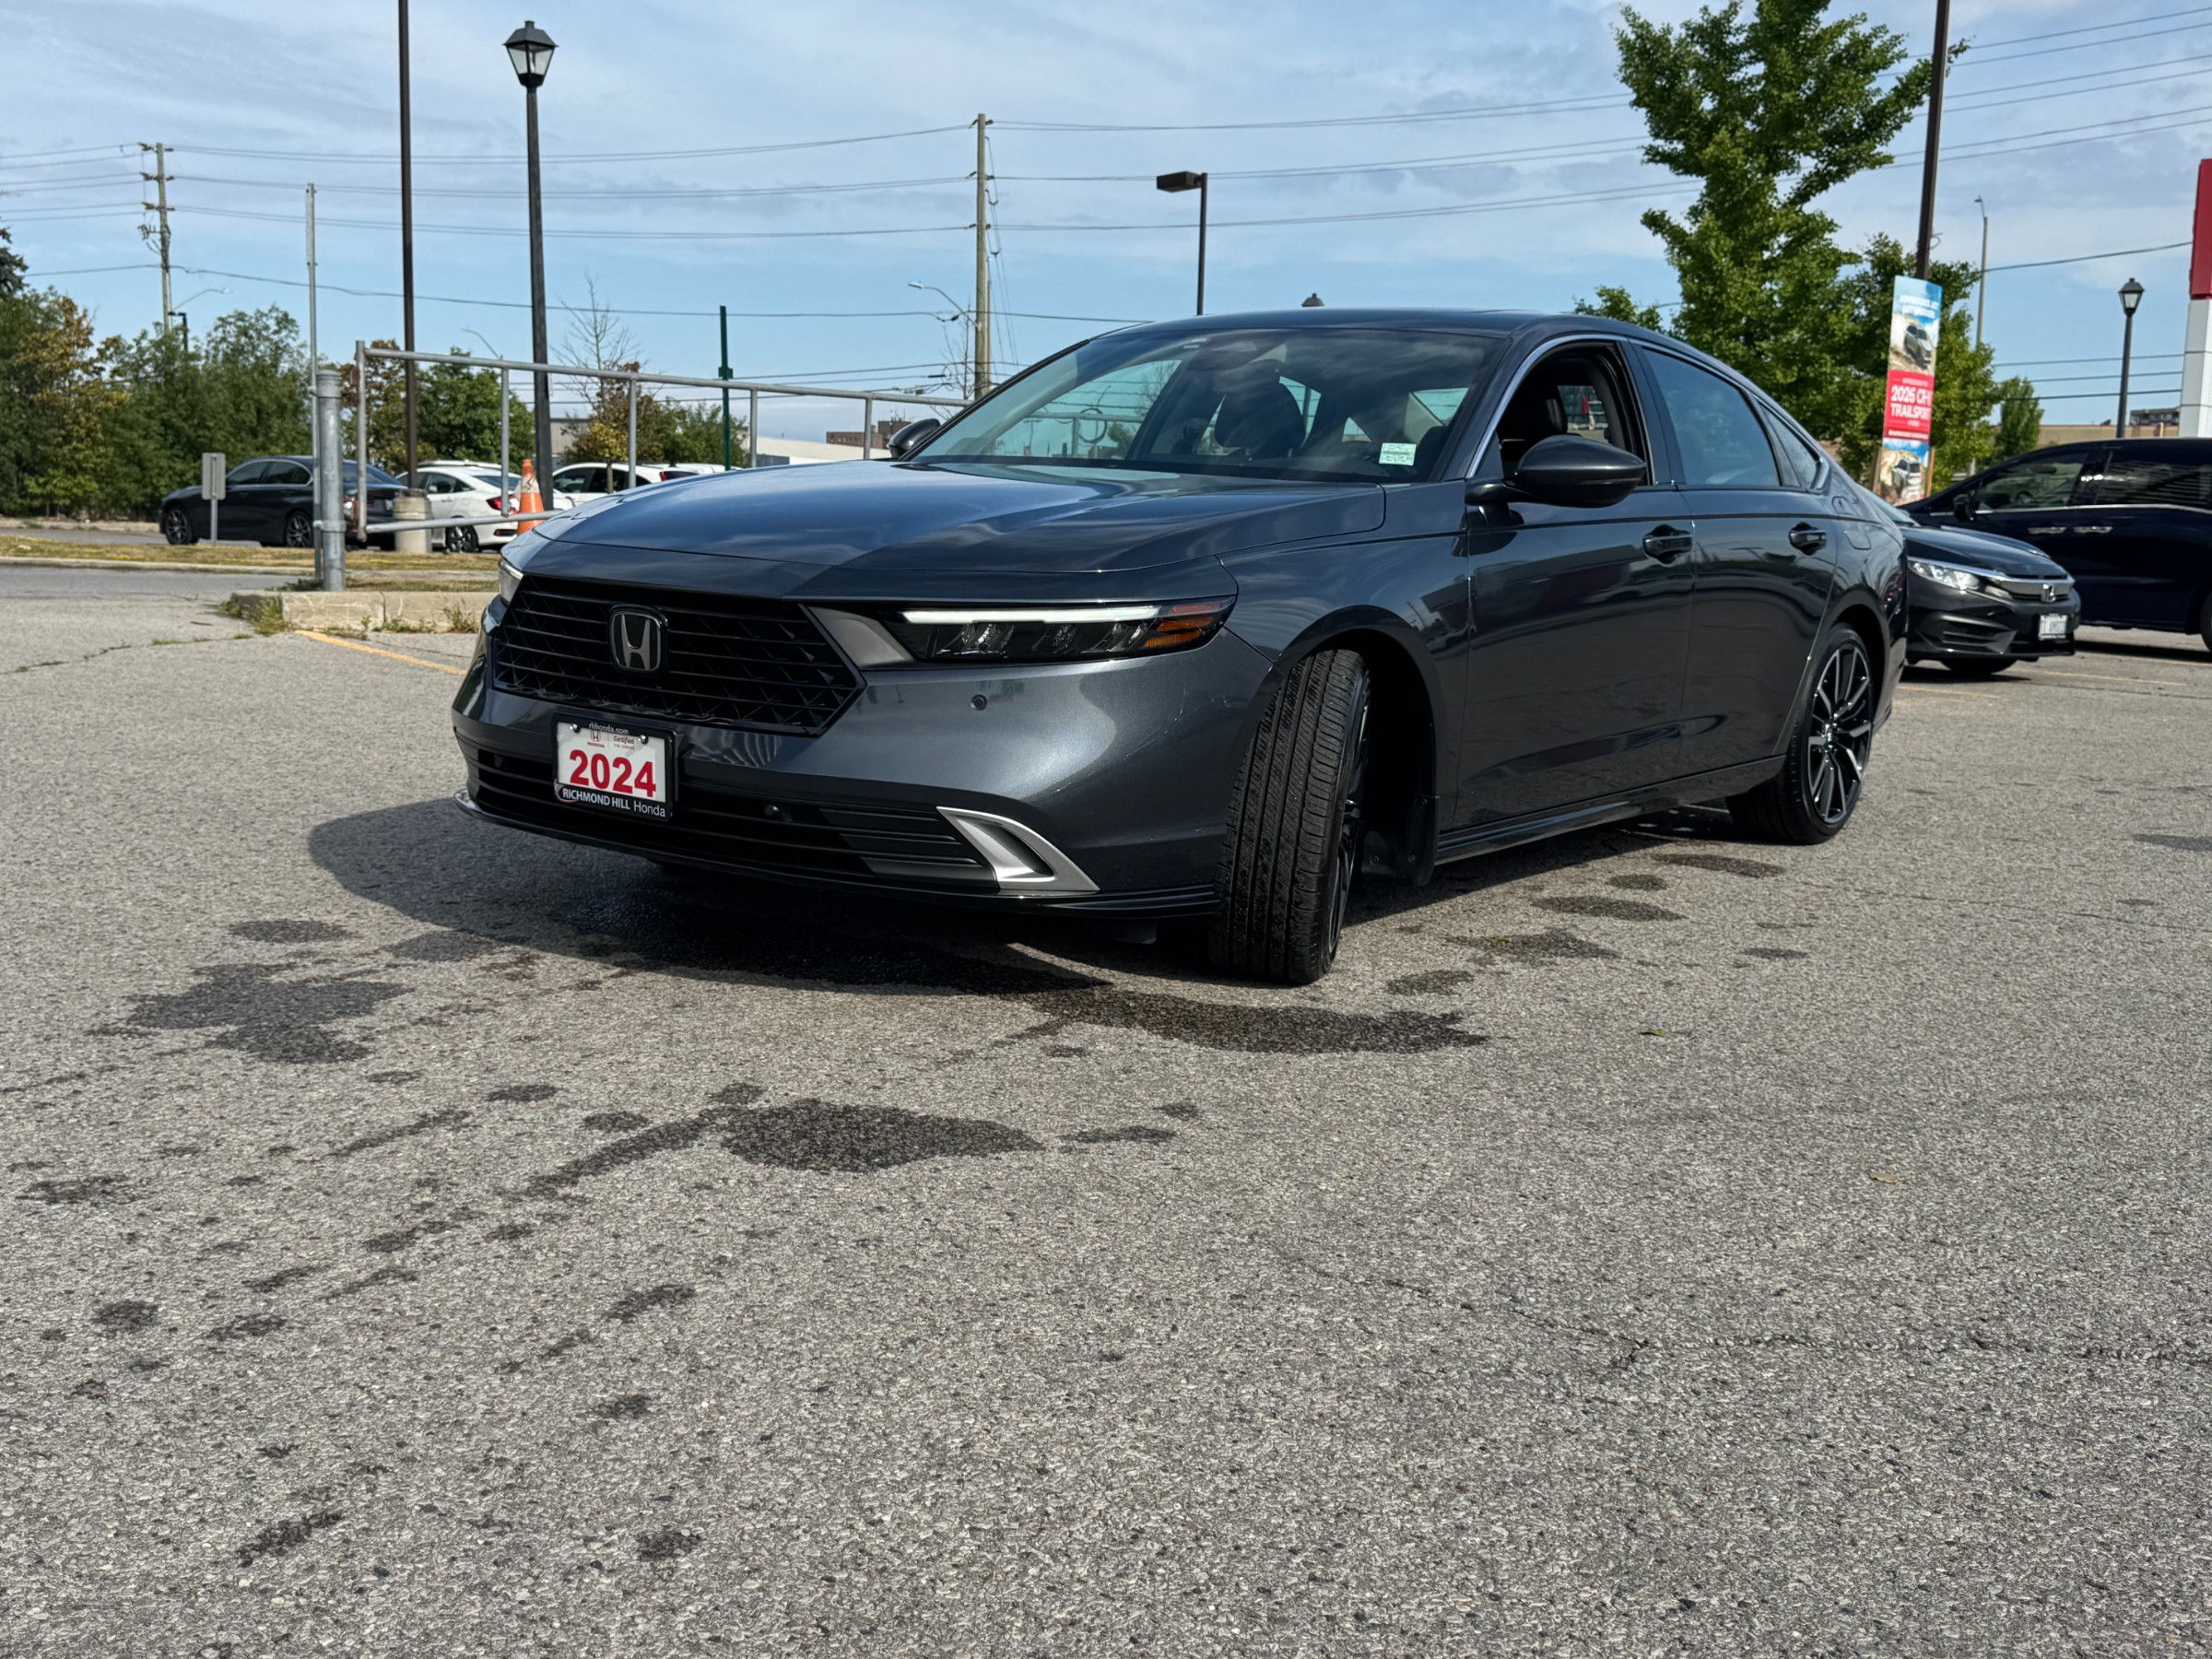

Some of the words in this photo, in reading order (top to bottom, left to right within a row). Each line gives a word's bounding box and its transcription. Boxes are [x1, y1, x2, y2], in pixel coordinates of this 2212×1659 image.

[588, 722, 629, 735] rhhonda.com
[570, 749, 657, 798] 2024
[562, 788, 610, 806] RICHMOND
[612, 796, 630, 809] HILL
[633, 800, 666, 818] Honda
